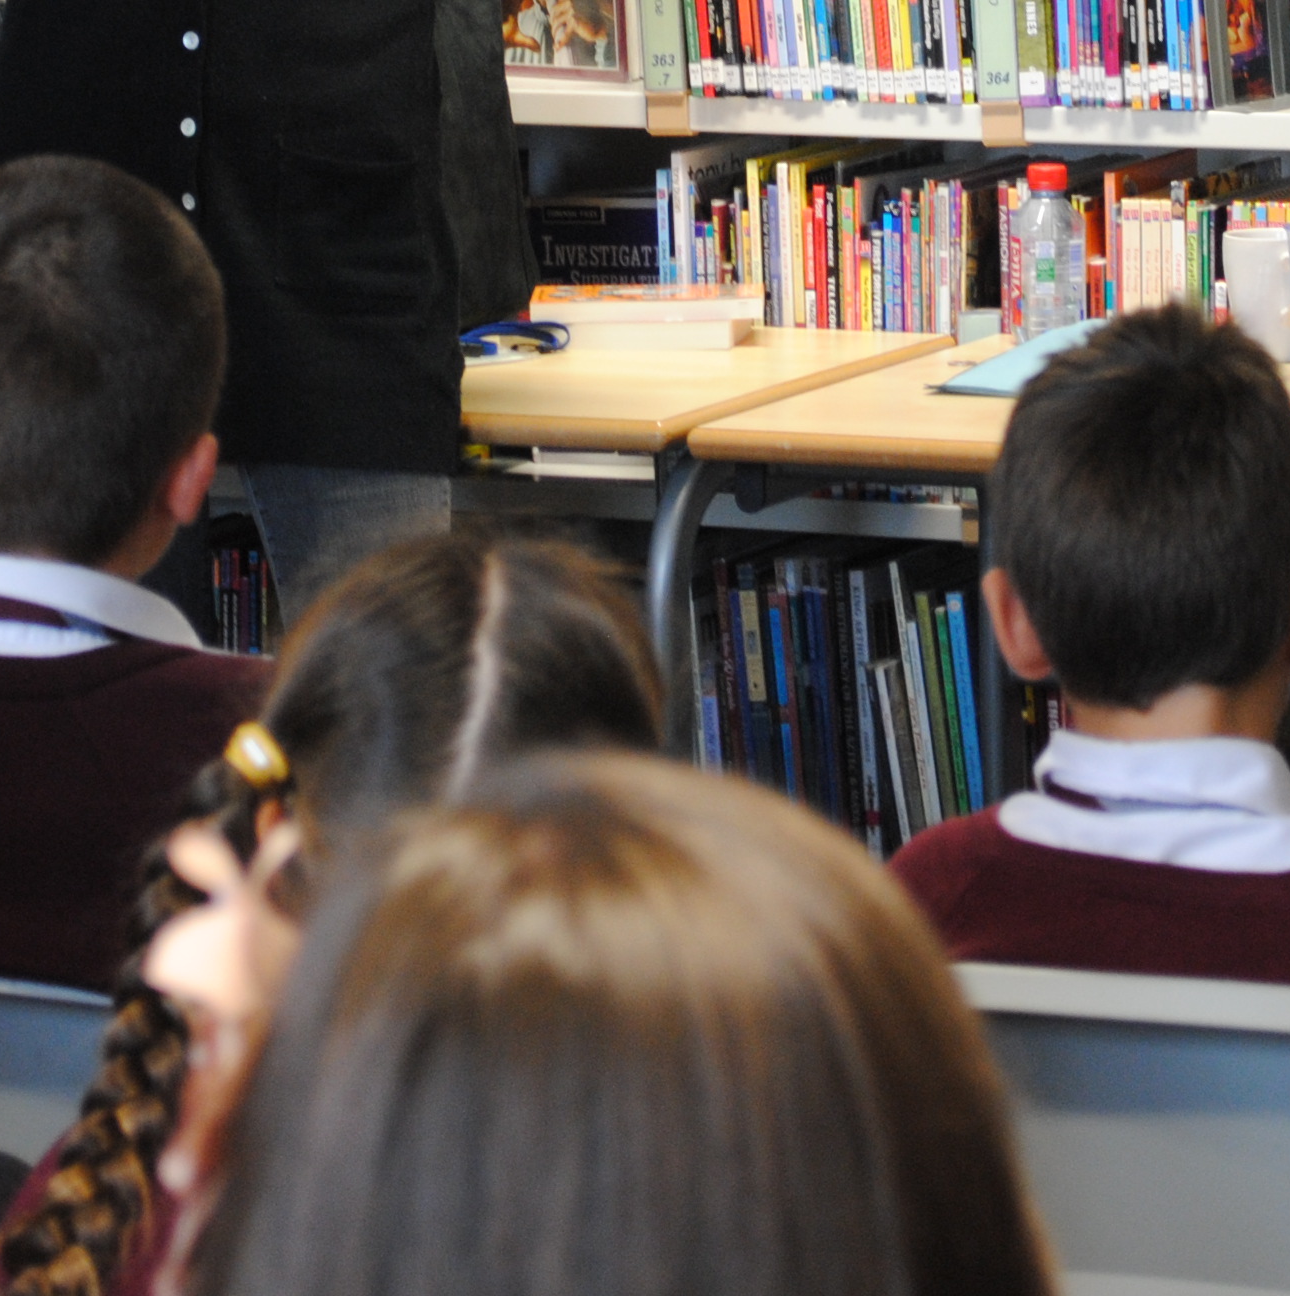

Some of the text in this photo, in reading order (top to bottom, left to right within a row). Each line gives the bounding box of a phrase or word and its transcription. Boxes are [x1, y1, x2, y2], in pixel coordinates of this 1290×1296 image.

[1025, 1, 1038, 35] INNES
[652, 53, 676, 67] 363
[986, 72, 1009, 85] 364
[998, 205, 1009, 272] FASHION
